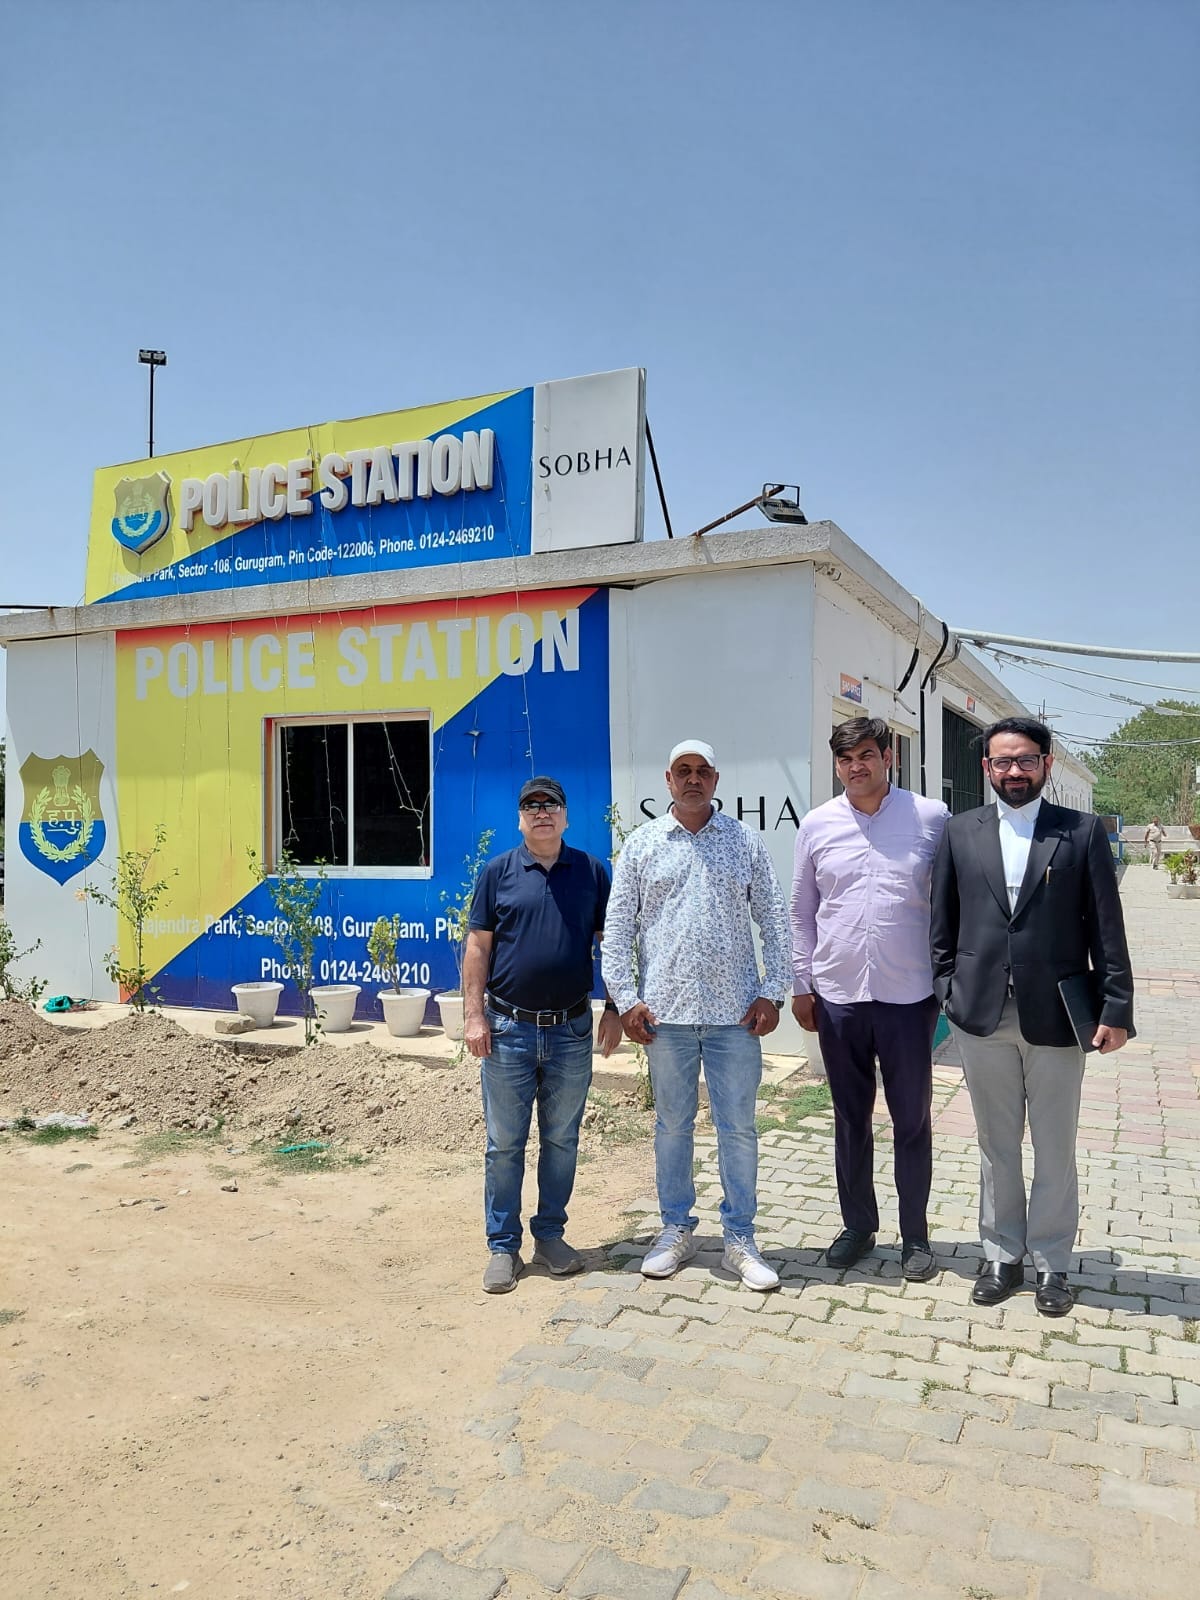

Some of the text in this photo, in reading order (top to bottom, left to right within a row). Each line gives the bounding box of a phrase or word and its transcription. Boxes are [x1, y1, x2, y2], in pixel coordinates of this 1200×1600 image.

[180, 428, 495, 532] POLICE STATION
[539, 446, 632, 478] SOBHA
[178, 563, 207, 579] Sector
[210, 558, 232, 575] -108,
[235, 555, 285, 573] Gurugram,
[288, 549, 304, 565] Pin
[308, 541, 376, 562] Code-122006,
[379, 539, 416, 555] Phone.
[420, 525, 495, 548] 0124-2469210
[135, 608, 579, 700] POLICE STATION
[639, 796, 801, 831] SHA
[205, 914, 241, 938] Park,
[343, 916, 429, 943] Guram,
